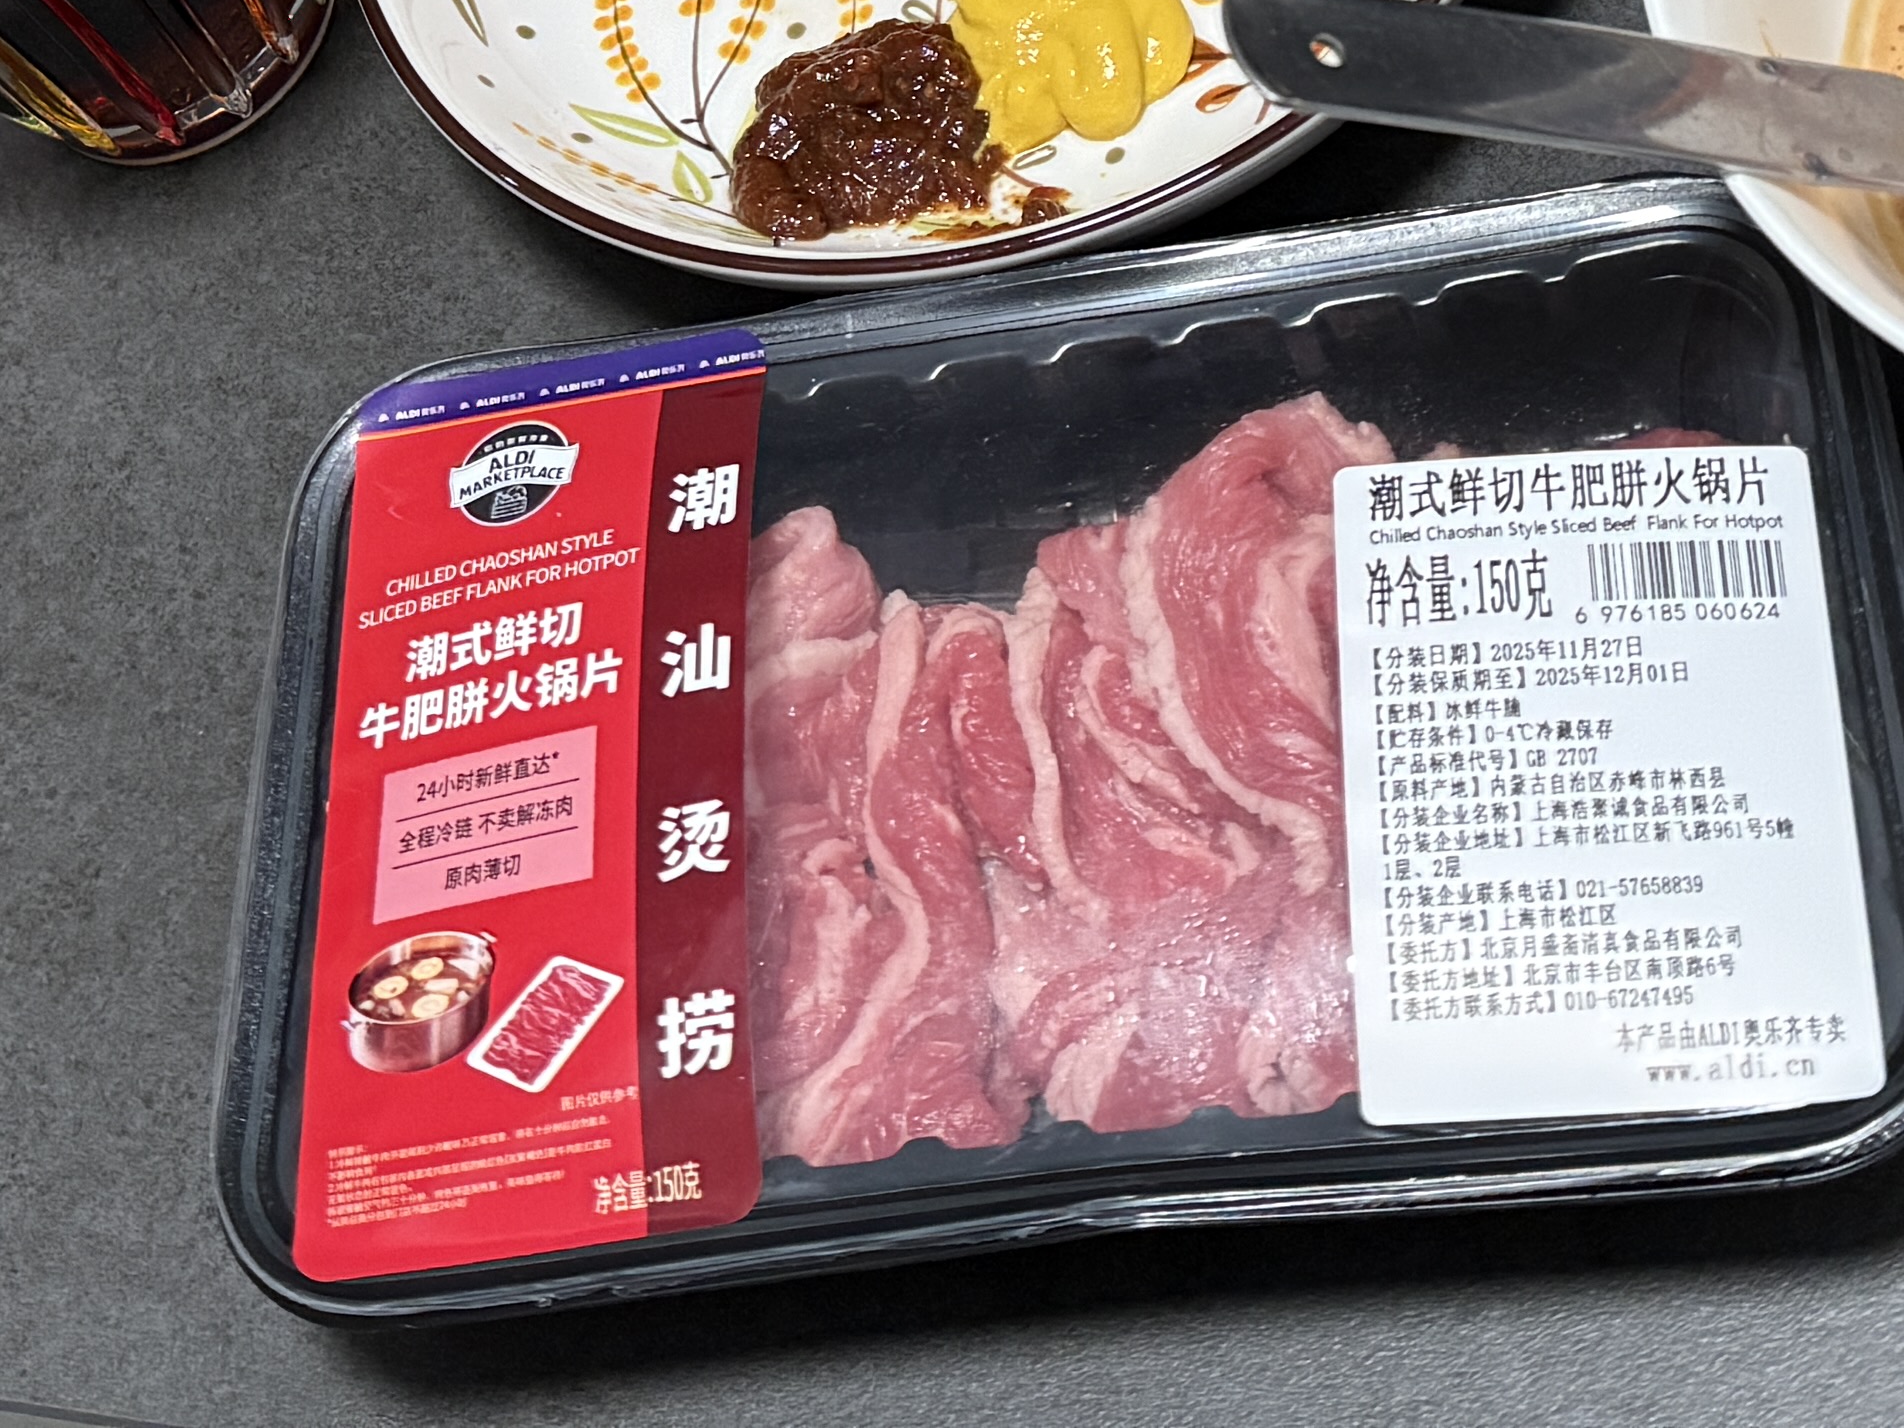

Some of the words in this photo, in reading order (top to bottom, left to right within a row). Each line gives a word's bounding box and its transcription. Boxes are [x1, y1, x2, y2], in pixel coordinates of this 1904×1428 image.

[458, 465, 566, 500] MARKETPLACE
[487, 448, 536, 474] ALDI
[1368, 456, 1770, 521] 潮式鲜切牛肥胼火锅片
[1369, 526, 1422, 545] Chilled
[1426, 522, 1503, 542] Chaoshan
[1508, 520, 1548, 540] Style
[1550, 516, 1597, 535] Sliced
[1603, 515, 1636, 532] Beef
[1647, 515, 1687, 531] Flank
[1694, 514, 1719, 530] For
[1724, 511, 1784, 532] Hotpot
[385, 565, 457, 598] CHILLED
[458, 539, 558, 578] CHAOSHAN
[560, 528, 615, 556] STYLE
[358, 599, 419, 631] SLICED
[420, 585, 464, 614] BEEF
[465, 573, 524, 603] FLANK
[524, 562, 562, 589] FOR
[563, 546, 641, 579] HOTPOT
[1574, 605, 1588, 625] 6
[1601, 602, 1686, 624] 976185
[1695, 601, 1781, 621] 060624
[404, 600, 584, 684] 潮式鲜切
[357, 647, 624, 750] 牛肥胼火锅片
[398, 817, 473, 855] 全程冷链
[477, 795, 574, 836] 不卖解冻肉
[443, 854, 522, 892] 原肉薄切
[1646, 1054, 1816, 1084] www.aldi.cn
